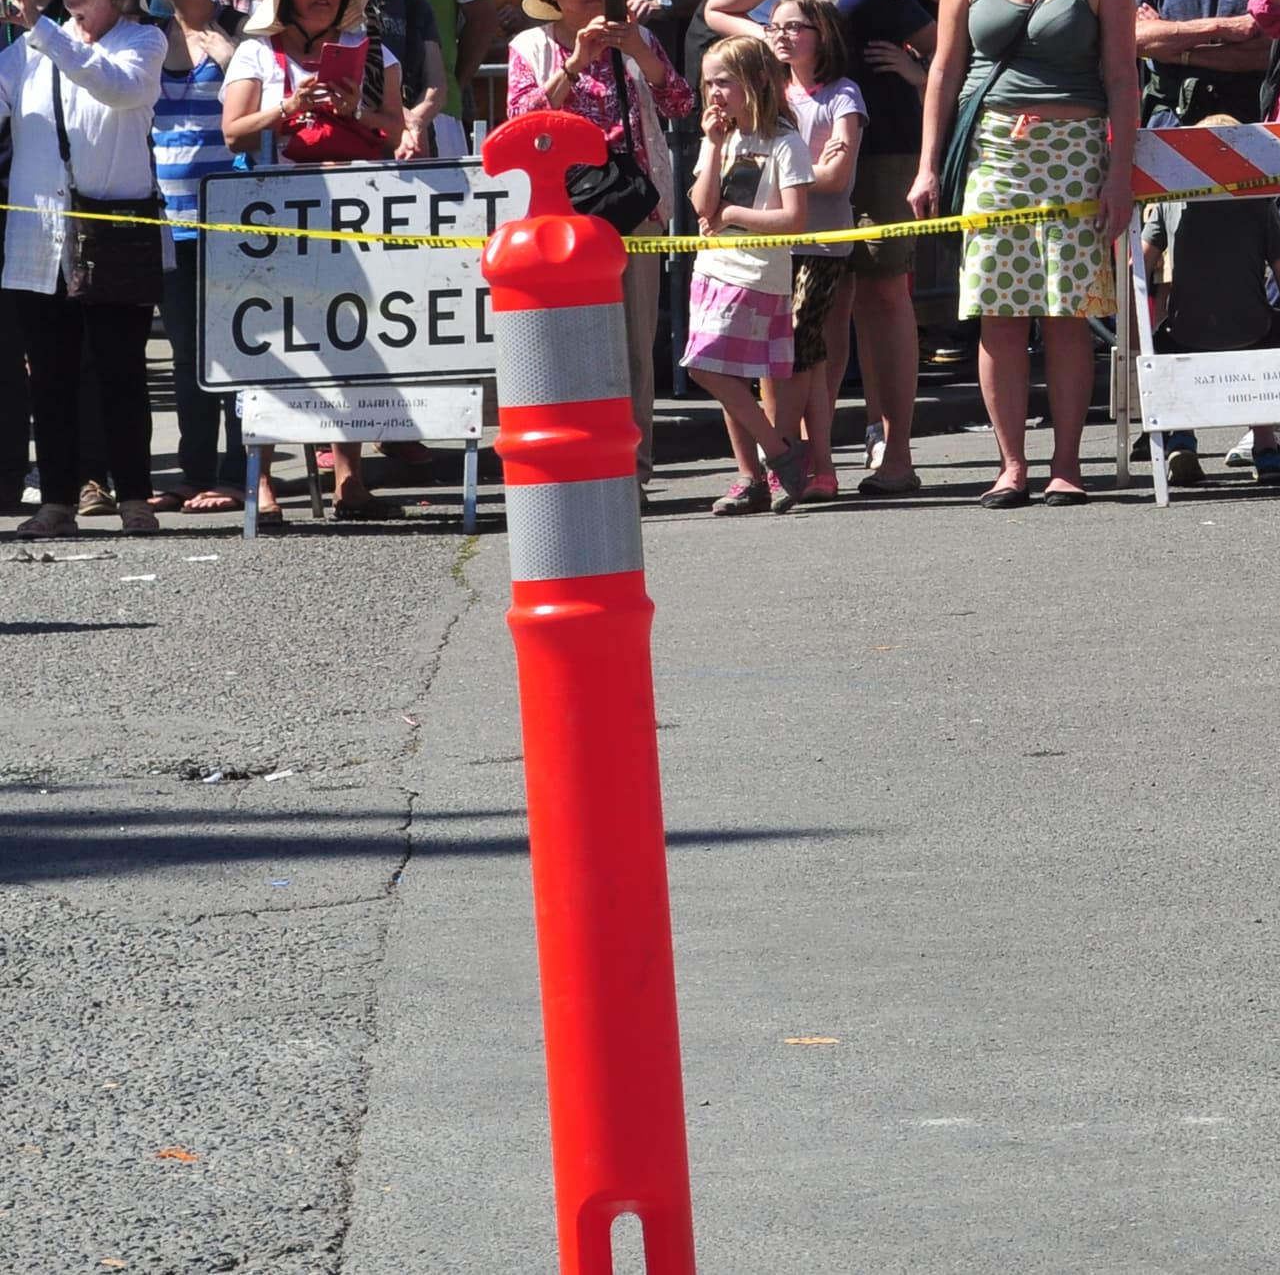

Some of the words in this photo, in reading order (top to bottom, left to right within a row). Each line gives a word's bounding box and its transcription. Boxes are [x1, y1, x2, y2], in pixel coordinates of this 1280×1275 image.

[238, 190, 509, 259] STREET
[1193, 373, 1256, 385] NATIONAL
[287, 400, 351, 410] NATIONAL
[357, 398, 429, 409] BARRICADE
